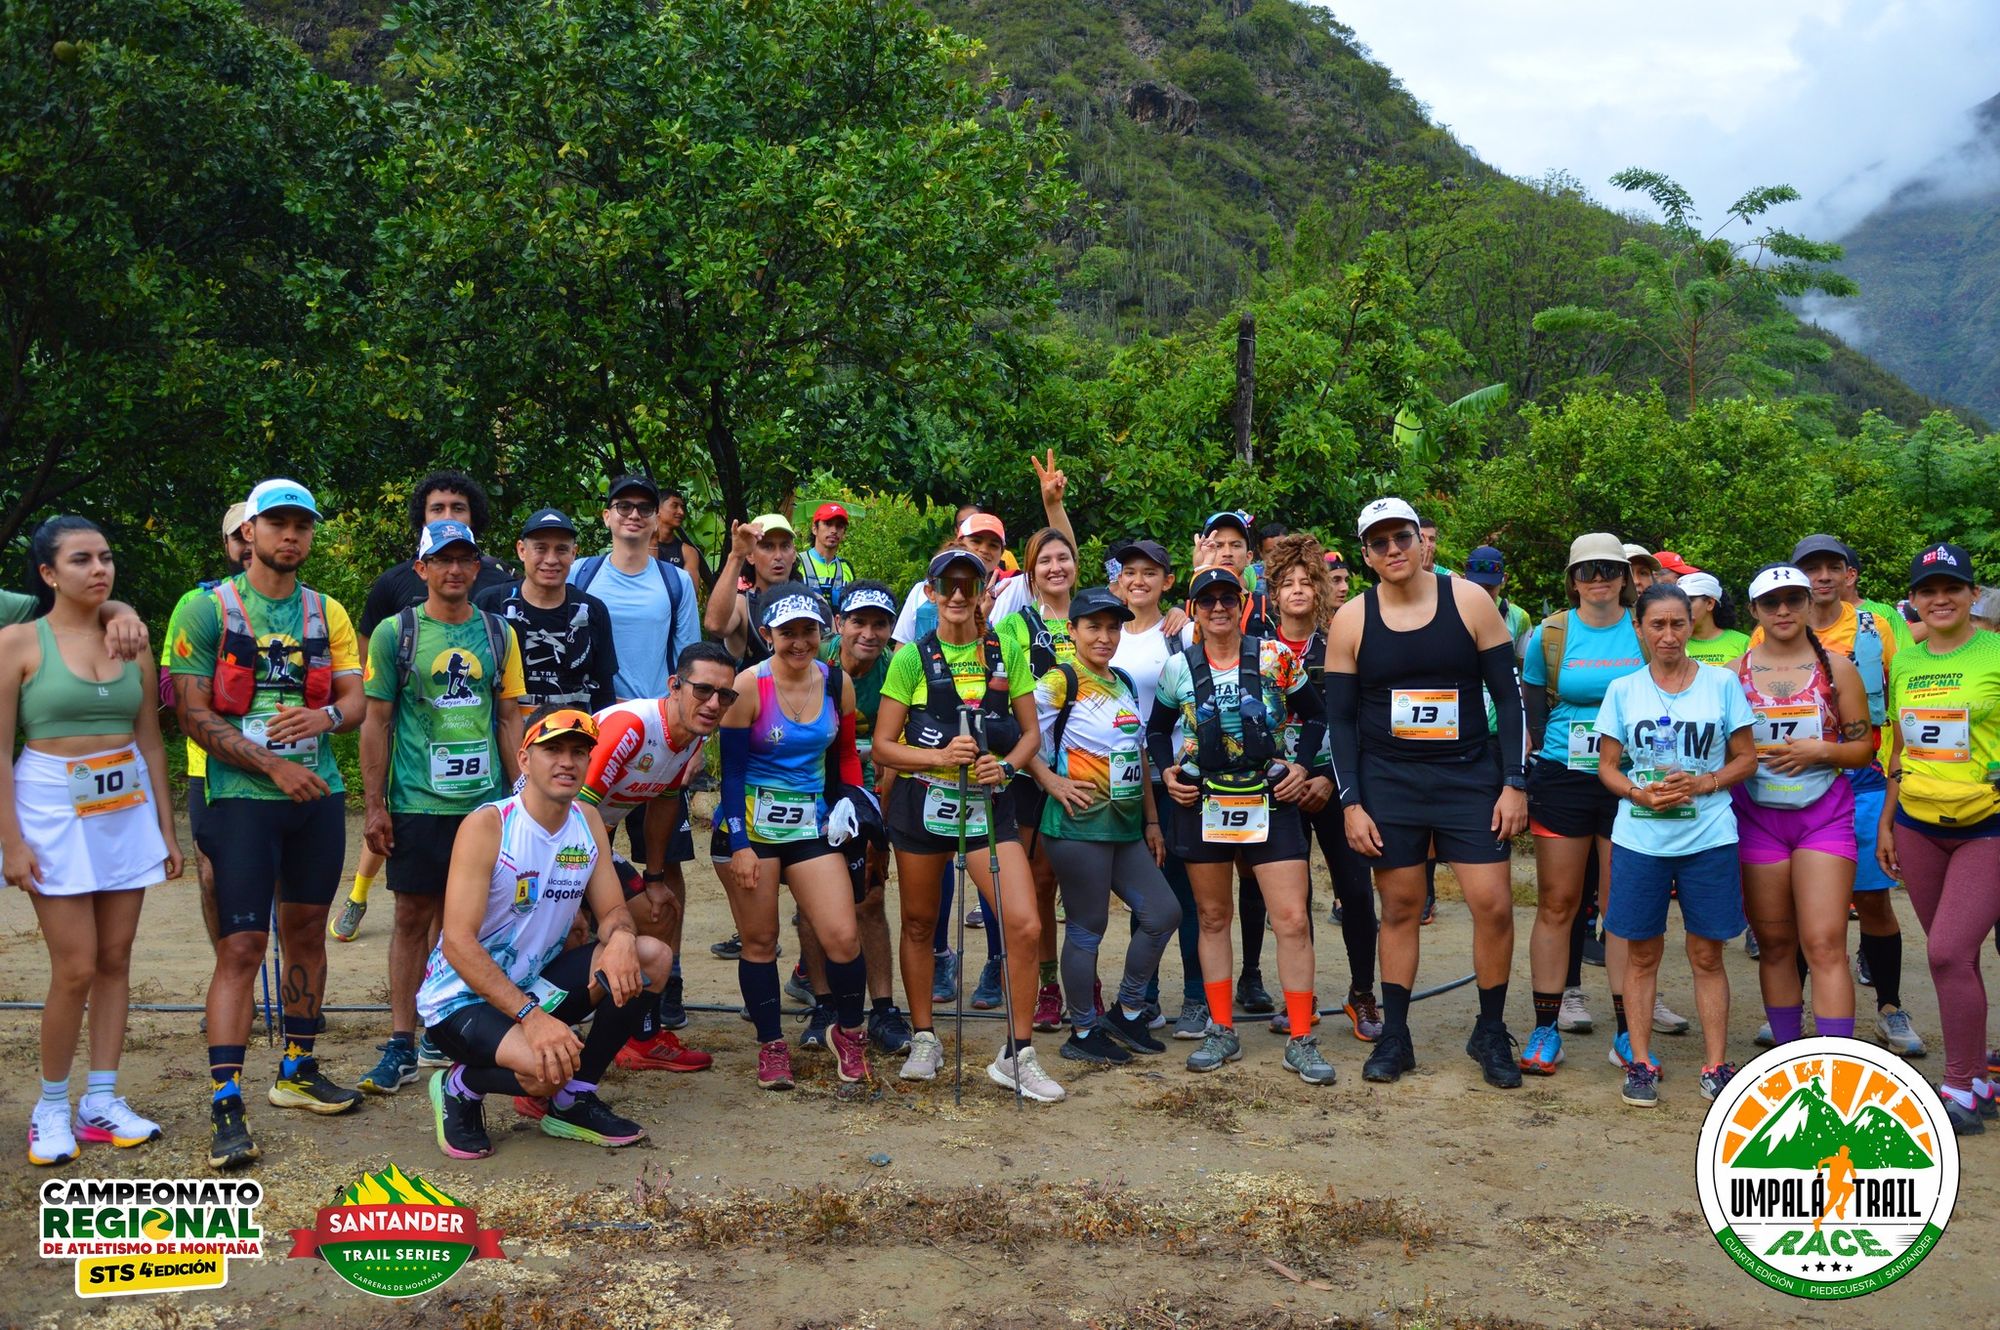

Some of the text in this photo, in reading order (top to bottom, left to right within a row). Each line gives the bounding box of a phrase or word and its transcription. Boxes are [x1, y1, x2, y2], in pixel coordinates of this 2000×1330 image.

[1906, 680, 1962, 690] REGIONAL
[1908, 673, 1964, 682] CAMPEONATO
[1412, 706, 1438, 724] 13
[1770, 722, 1798, 740] 17
[1920, 726, 1940, 744] 2
[446, 757, 480, 776] 38
[600, 727, 640, 788] ARATOCA
[94, 770, 124, 794] 10
[1122, 764, 1140, 782] 40
[767, 806, 804, 824] 23
[1221, 810, 1248, 826] 19
